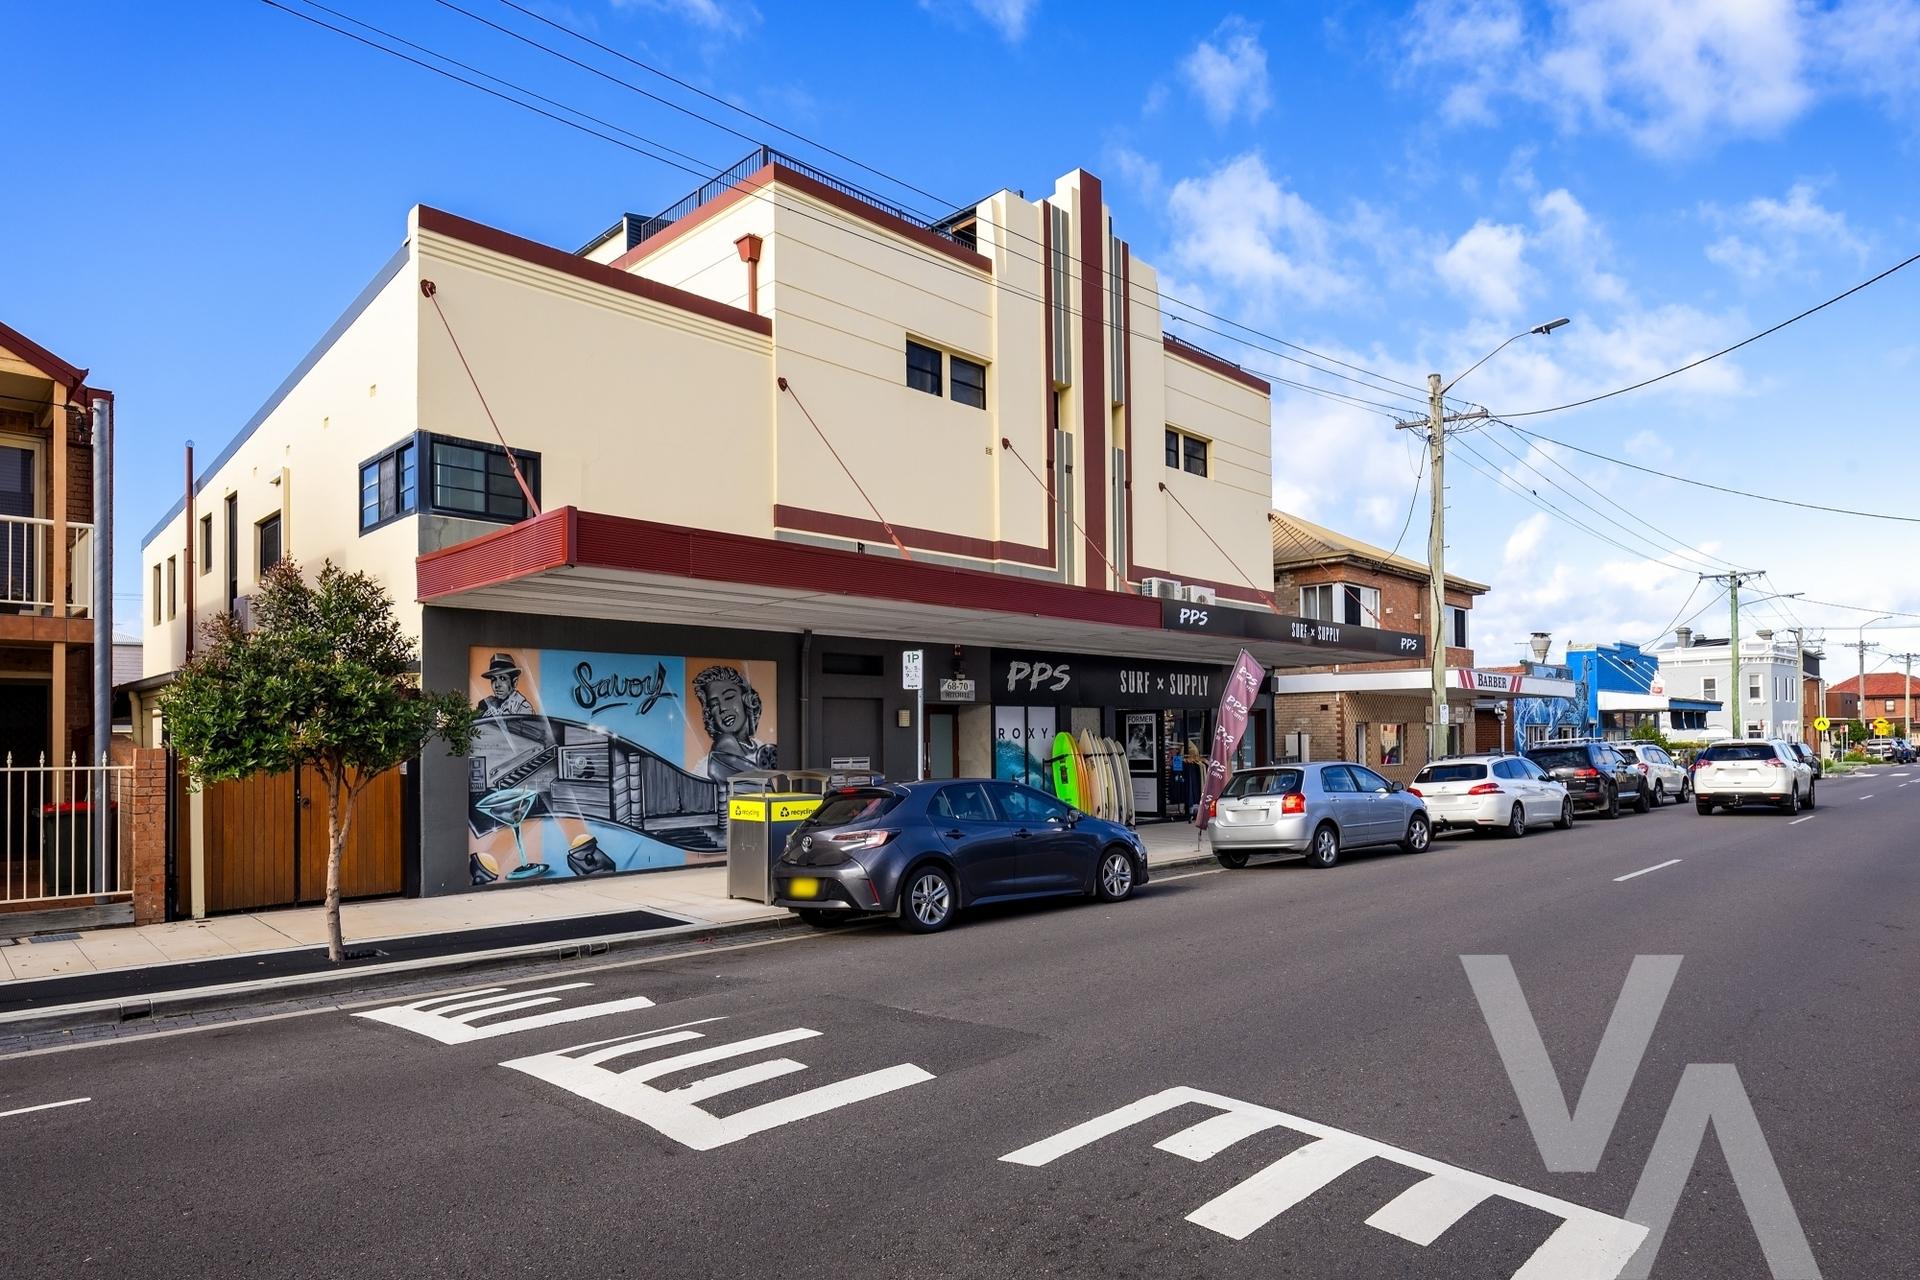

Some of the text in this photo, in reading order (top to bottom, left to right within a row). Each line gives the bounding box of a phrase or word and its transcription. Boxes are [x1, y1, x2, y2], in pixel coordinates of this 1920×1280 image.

[1179, 607, 1208, 626] PPS
[1291, 622, 1308, 638] SURF
[1317, 628, 1340, 642] SUPPLY
[1400, 637, 1417, 650] PPS
[907, 653, 920, 663] 1P
[1007, 660, 1071, 692] PPS
[1120, 670, 1150, 693] SURF
[1169, 673, 1209, 696] SUPPLY
[1239, 666, 1258, 686] PPS
[573, 661, 678, 715] Savoy
[947, 681, 969, 691] 68-70
[1226, 695, 1248, 714] PPS
[1127, 715, 1153, 723] FORMER
[1210, 758, 1227, 773] PS
[790, 807, 816, 816] recyclin
